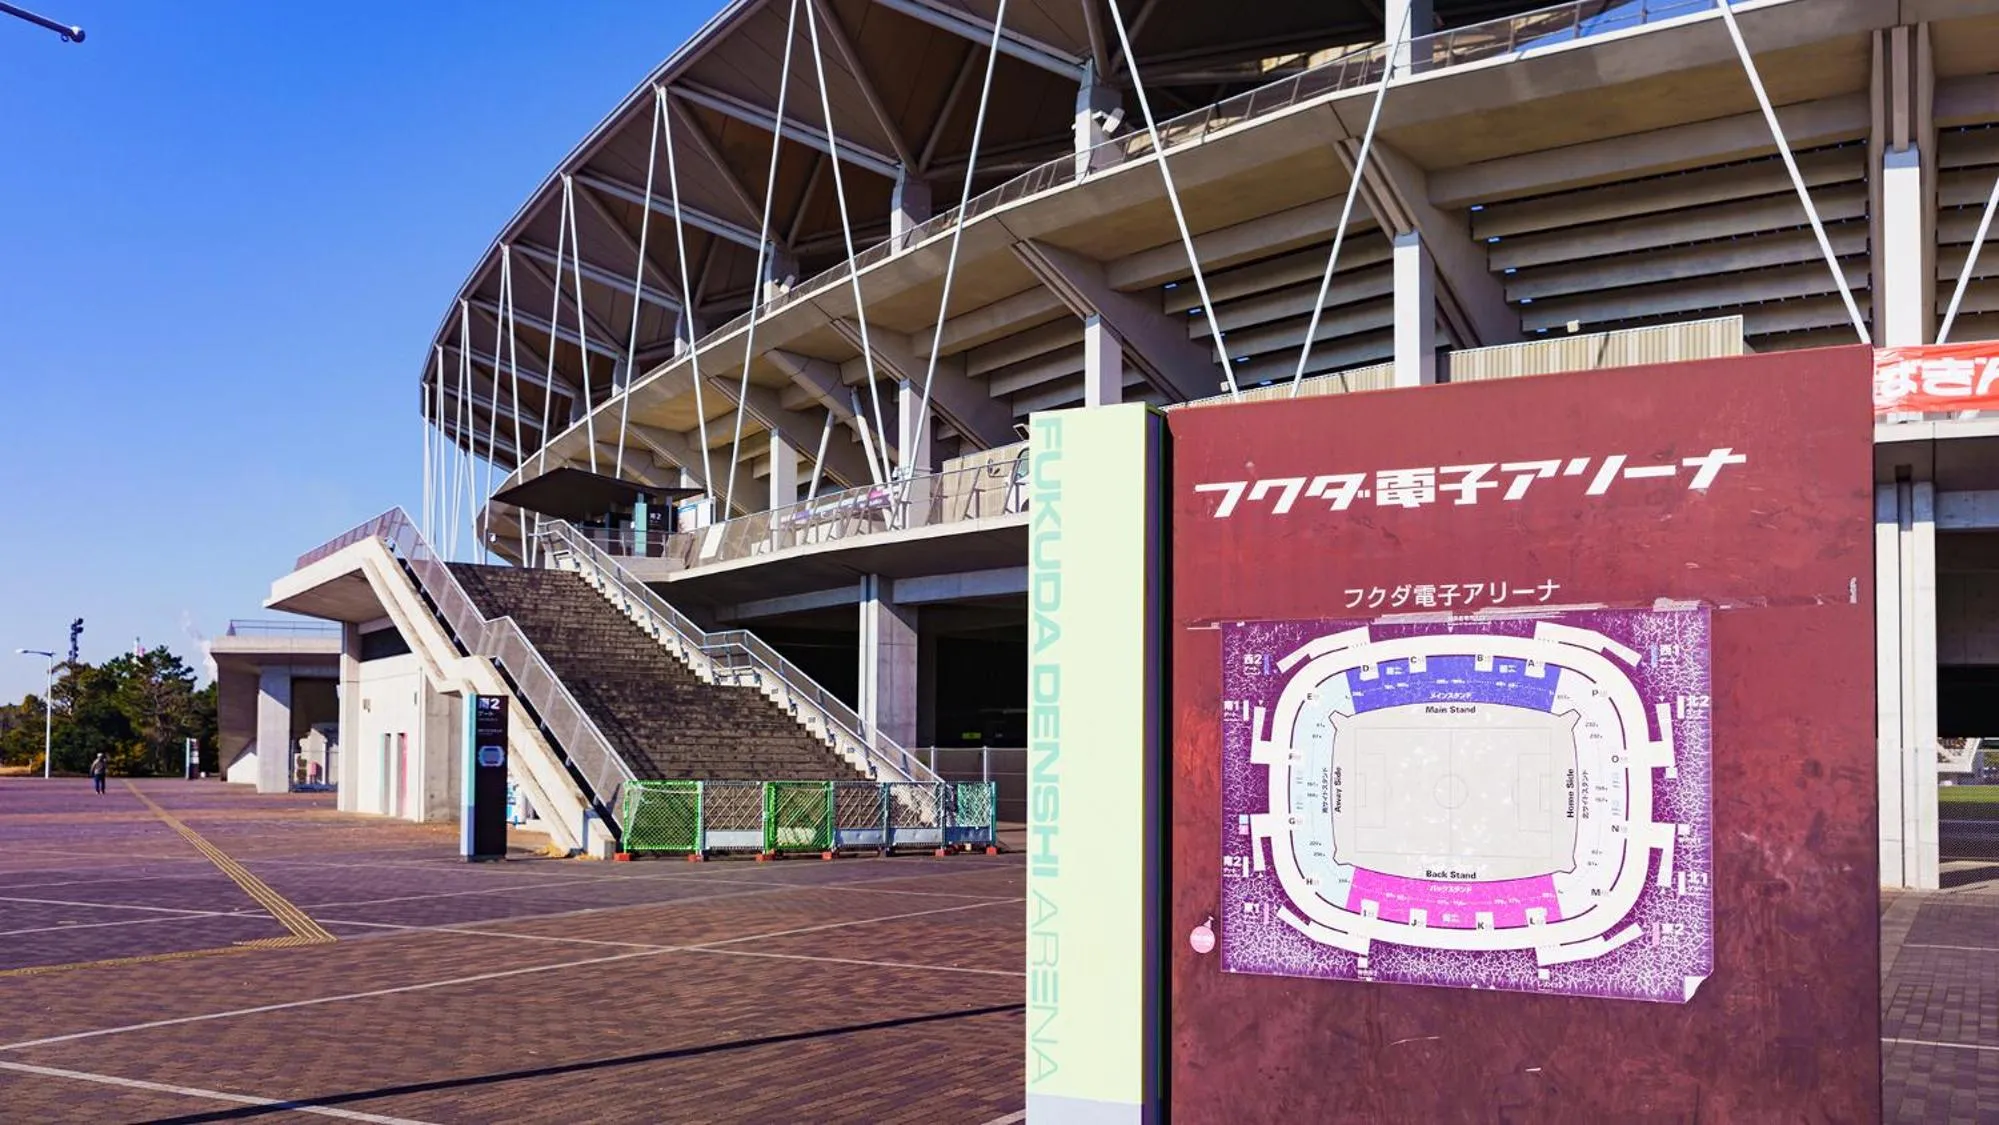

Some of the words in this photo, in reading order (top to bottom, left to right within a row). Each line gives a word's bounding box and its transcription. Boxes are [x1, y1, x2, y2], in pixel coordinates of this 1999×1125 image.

[1194, 447, 1746, 518] フクダ電子アリーナ
[1033, 417, 1063, 655] FUKUDA
[1344, 578, 1561, 609] フクダ電子アリーナ
[1425, 705, 1448, 713] Main
[1449, 705, 1476, 713] Stand
[1032, 663, 1061, 878] DENSHI
[1334, 767, 1342, 786] Side
[1566, 768, 1575, 789] Side
[1566, 791, 1575, 819] Home
[1425, 869, 1448, 878] Back
[1449, 871, 1477, 879] Stand
[1031, 889, 1059, 1084] ARENA
